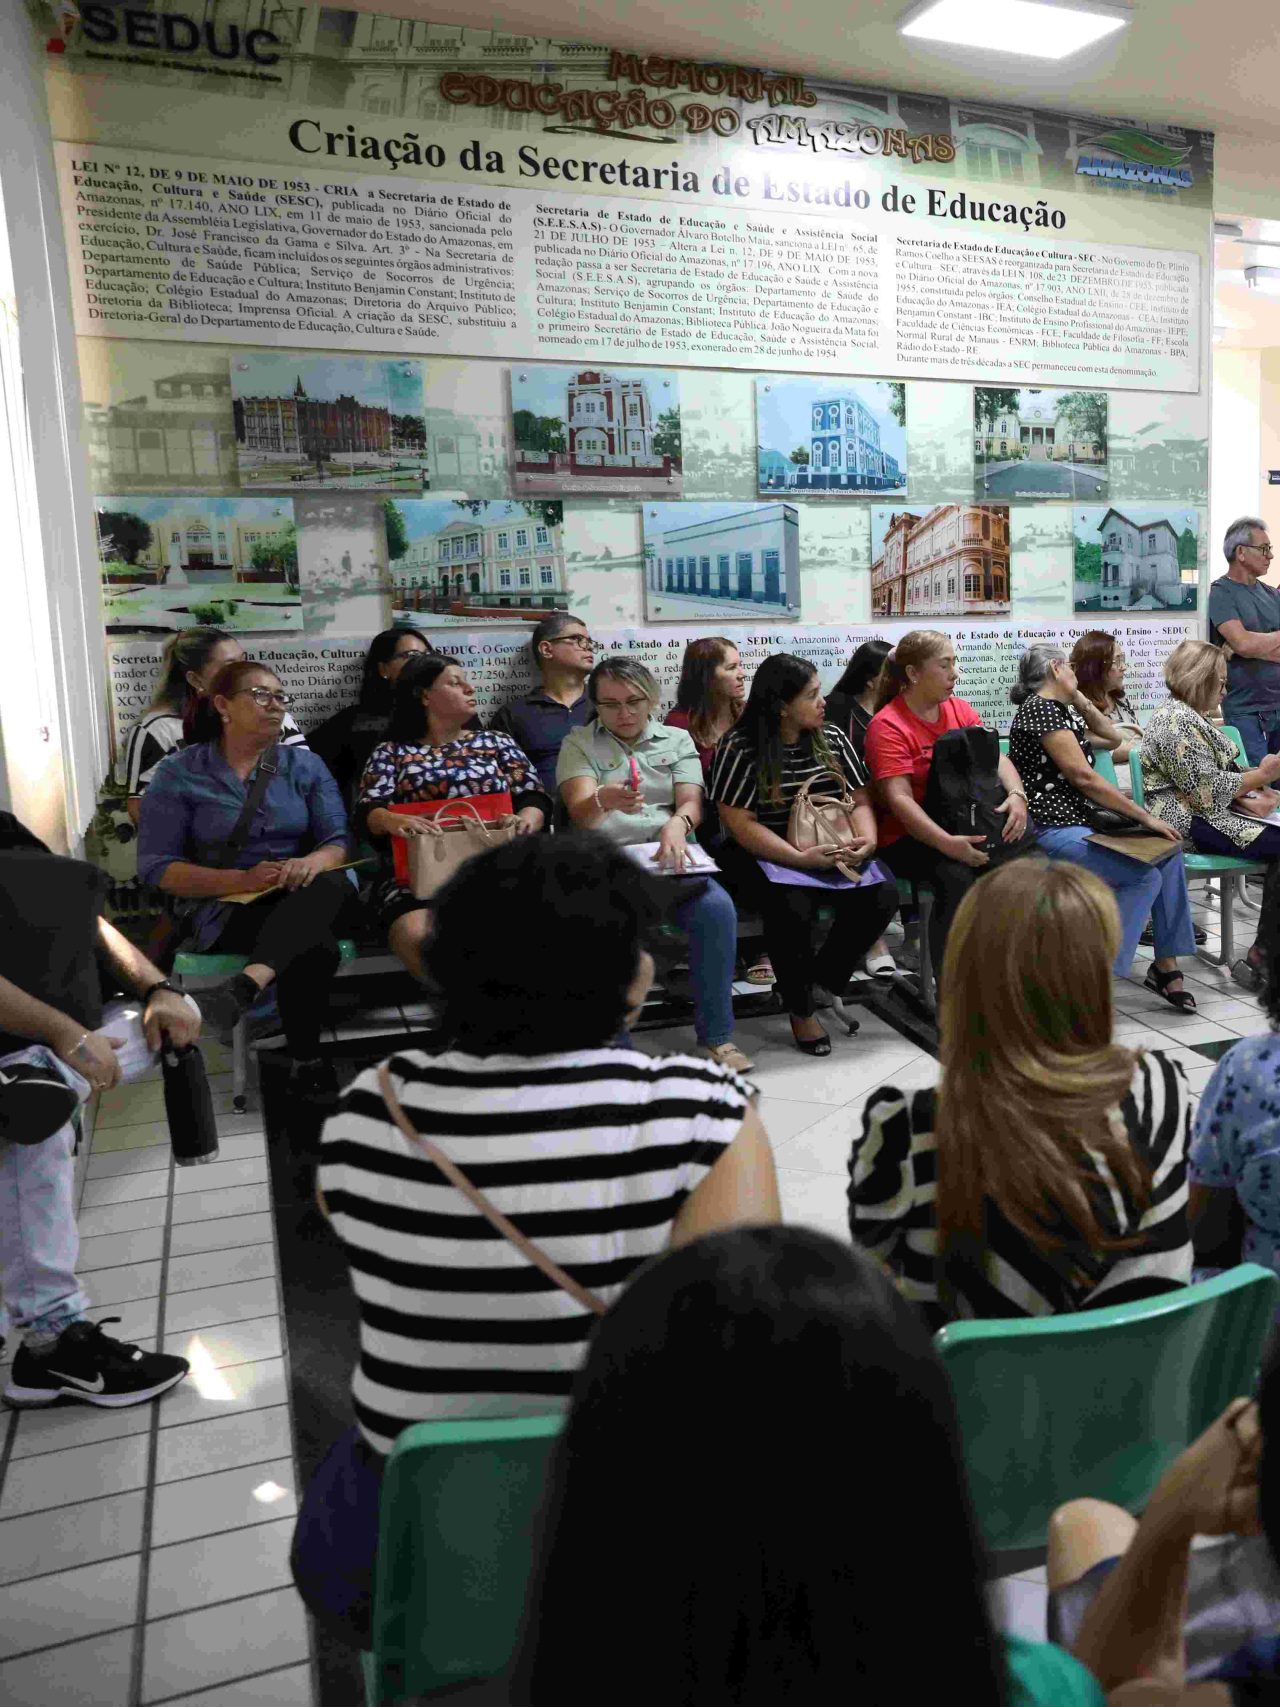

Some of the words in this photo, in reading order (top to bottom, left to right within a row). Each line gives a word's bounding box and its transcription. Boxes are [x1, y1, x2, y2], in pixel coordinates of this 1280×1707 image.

[82, 4, 280, 65] SEDUC
[608, 50, 817, 107] MEMORIAL
[440, 72, 676, 130] EDUCAÇÃO
[683, 103, 740, 137] DO
[747, 114, 956, 163] AMAZONAS
[72, 160, 98, 173] LEI
[104, 163, 120, 174] Nº
[126, 165, 144, 179] 12,
[150, 168, 169, 179] DE
[174, 170, 182, 180] 9
[188, 171, 204, 182] DE
[213, 173, 253, 186] MAIO
[258, 178, 276, 188] DE
[284, 180, 310, 192] 1953
[323, 184, 358, 196] CRIA
[378, 188, 435, 203] Secretaria
[440, 194, 452, 204] de
[458, 196, 494, 208] Estado
[498, 199, 510, 210] de
[289, 119, 446, 169] Criação
[460, 140, 505, 173] da
[519, 146, 700, 192] Secretaria
[712, 167, 750, 197] de
[764, 169, 871, 209] Estado
[882, 185, 916, 214] de
[927, 188, 1066, 231] Educação
[1076, 155, 1193, 188] AMAZONAS
[74, 176, 142, 194] Educação,
[152, 182, 202, 196] Cultura
[228, 189, 265, 202] Saúde
[274, 193, 322, 209] (SESC),
[332, 199, 384, 212] publicada
[393, 206, 406, 214] no
[415, 206, 447, 218] Diário
[456, 209, 490, 221] Oficial
[498, 212, 511, 223] do
[75, 190, 144, 208] Amazonas,
[150, 198, 162, 208] nº
[169, 198, 212, 214] 17.140,
[218, 202, 248, 215] ANO
[254, 206, 281, 219] LIX,
[286, 211, 303, 219] em
[310, 210, 320, 220] 11
[326, 212, 340, 222] de
[345, 214, 372, 225] maio
[377, 216, 390, 226] de
[396, 218, 424, 230] 1953,
[430, 222, 486, 234] sancionada
[491, 226, 512, 238] pelo
[77, 206, 141, 220] Presidente
[144, 211, 158, 222] da
[161, 212, 229, 228] Assembléia
[232, 218, 298, 234] Legislativa,
[302, 224, 366, 238] Governador
[369, 229, 382, 240] do
[386, 230, 421, 242] Estado
[423, 233, 436, 244] do
[439, 234, 494, 250] Amazonas,
[78, 223, 139, 237] exercício,
[146, 226, 164, 237] Dr.
[171, 228, 196, 240] José
[204, 230, 259, 244] Francisco
[264, 234, 278, 246] da
[284, 236, 318, 248] Gama
[336, 240, 367, 252] Silva.
[372, 243, 392, 254] Art.
[400, 245, 409, 254] 3º
[426, 247, 440, 257] Na
[446, 248, 496, 262] Secretaria
[502, 252, 513, 262] de
[536, 204, 588, 217] Secretaria
[598, 209, 608, 218] de
[618, 210, 651, 222] Estado
[660, 214, 670, 224] de
[680, 216, 725, 230] Educação
[746, 222, 774, 233] Saúde
[796, 226, 843, 239] Assistência
[851, 231, 877, 242] Social
[80, 236, 144, 252] Educação,
[146, 240, 190, 253] Cultura
[202, 244, 240, 258] Saúde,
[244, 247, 275, 259] ficam
[278, 250, 328, 263] incluídos
[344, 256, 394, 268] seguintes
[396, 258, 430, 272] órgãos
[432, 261, 513, 276] administrativos:
[896, 236, 940, 248] Secretaria
[942, 240, 951, 248] de
[954, 241, 982, 252] Estado
[984, 244, 992, 252] de
[994, 244, 1034, 258] Educação
[1041, 249, 1072, 260] Cultura
[1078, 252, 1095, 262] SEC
[611, 641, 623, 650] de
[629, 640, 662, 649] Estado
[668, 639, 680, 648] da
[747, 636, 786, 645] SEDUC.
[791, 636, 840, 644] Amazonino
[792, 645, 844, 659] organização
[971, 631, 998, 640] Estado
[1004, 630, 1012, 638] de
[1018, 629, 1056, 639] Educação
[1126, 628, 1152, 636] Ensino
[112, 655, 163, 664] Secretar
[260, 650, 318, 661] Educação,
[321, 649, 365, 659] Cultura
[483, 645, 492, 654] O
